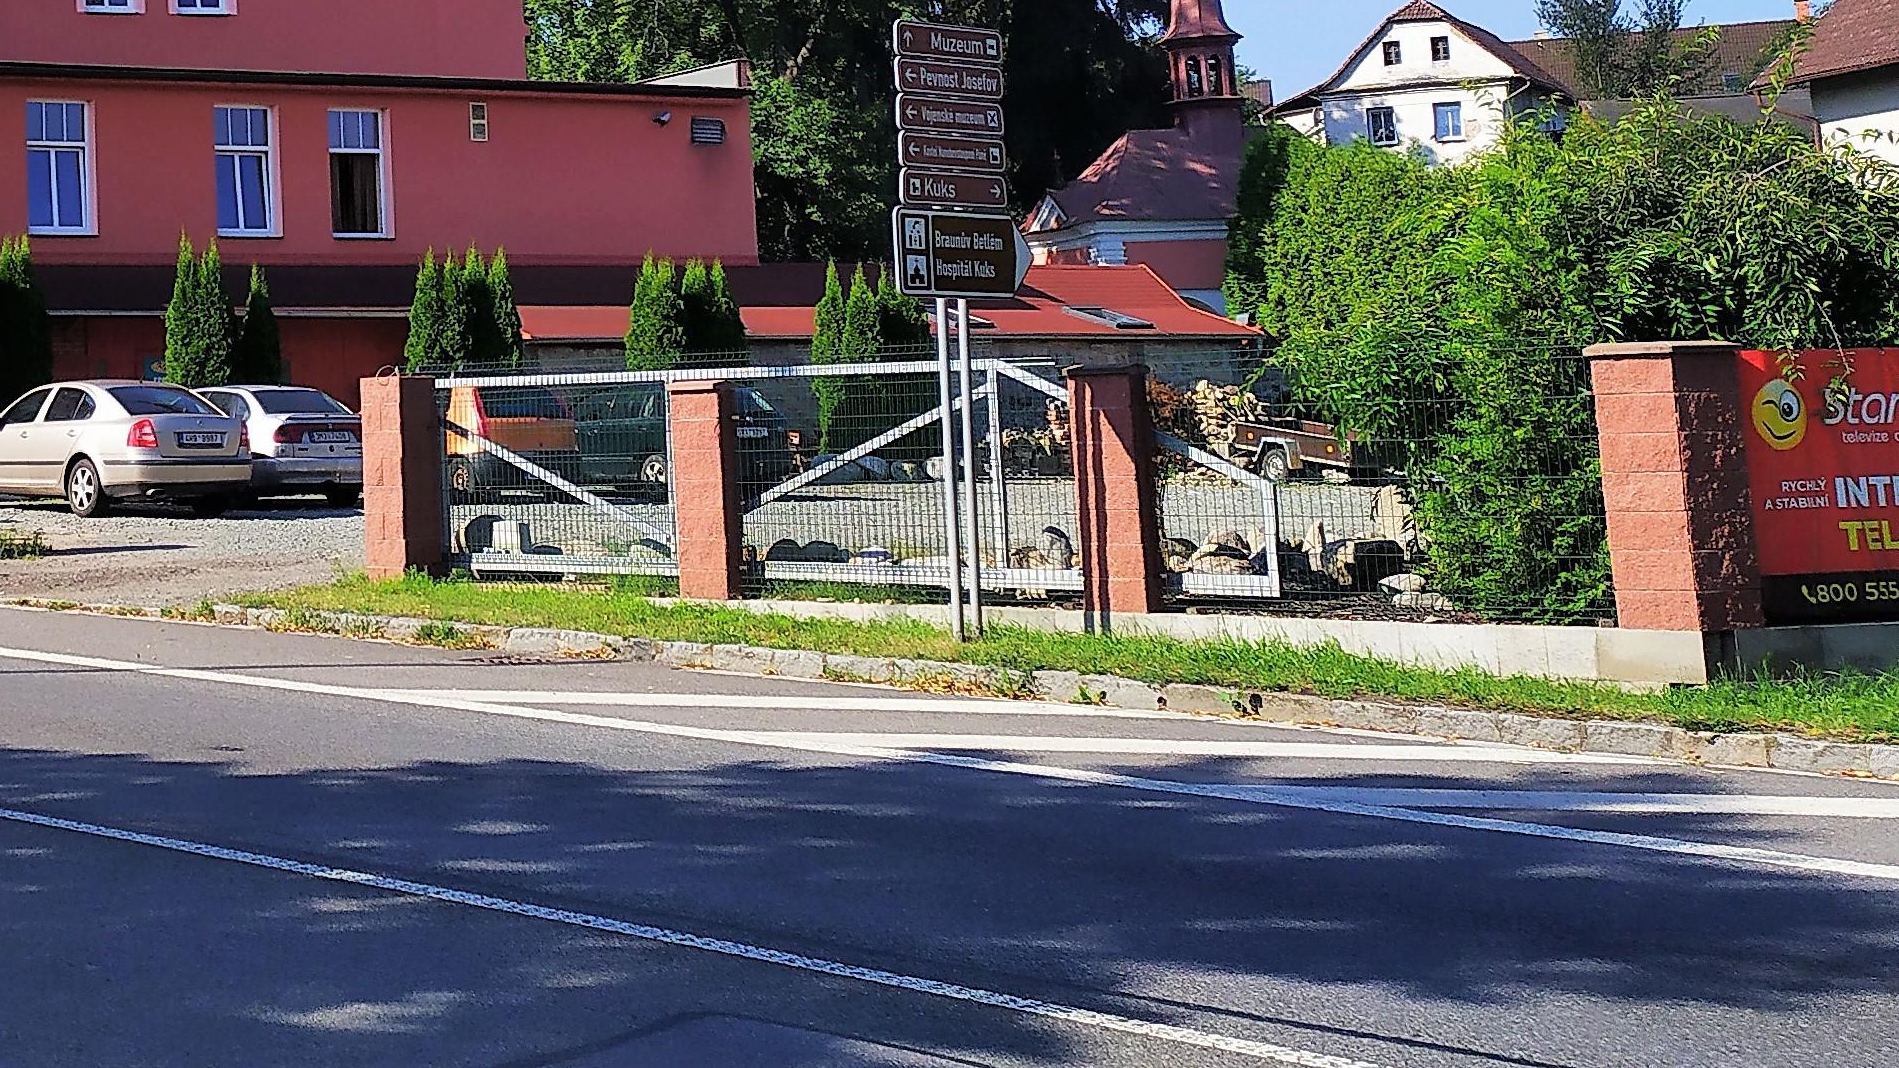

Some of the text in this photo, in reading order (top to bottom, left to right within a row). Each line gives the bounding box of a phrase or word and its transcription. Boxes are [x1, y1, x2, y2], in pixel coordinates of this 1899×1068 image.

[930, 32, 984, 54] Muzeum
[919, 66, 998, 92] Pevnost Josefov
[924, 177, 956, 199] Kuks
[934, 229, 1004, 251] Braunův Betlém
[935, 258, 996, 281] Hospitál Kuks
[1842, 430, 1889, 443] televize
[1781, 476, 1827, 492] RYCHLÝ
[1764, 493, 1830, 510] A STABILNÍ
[1816, 581, 1899, 603] 800 555
